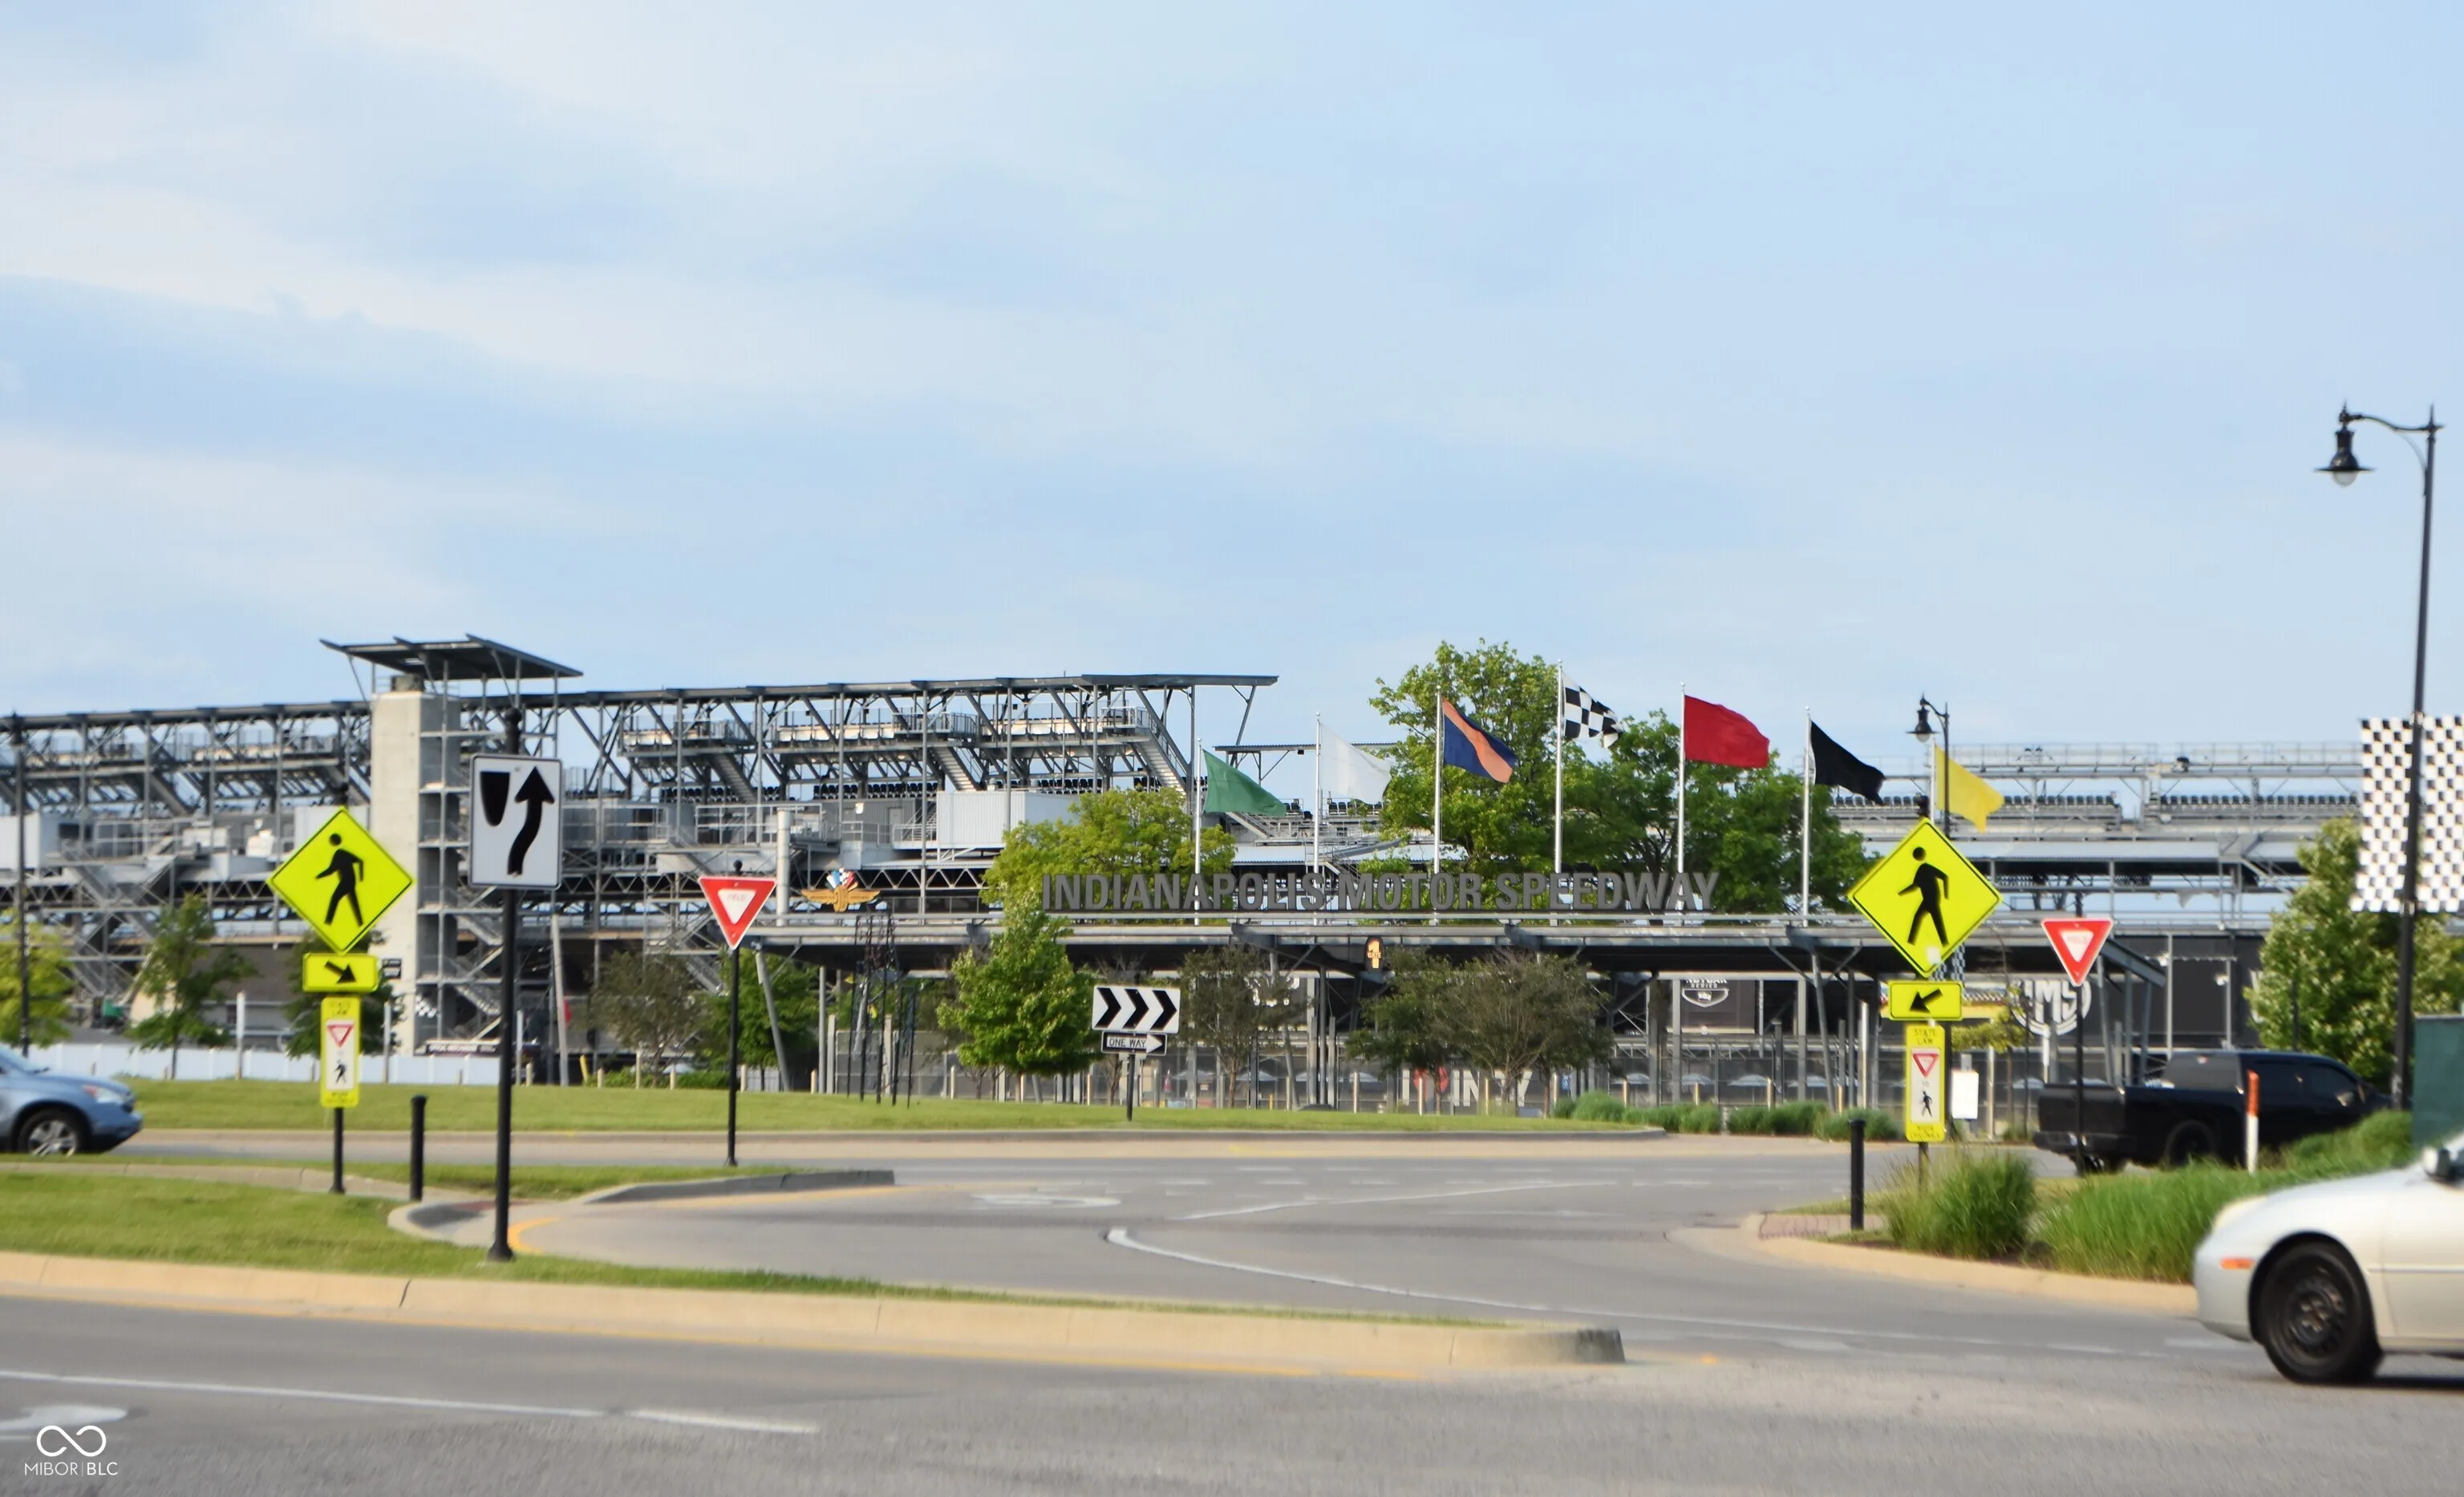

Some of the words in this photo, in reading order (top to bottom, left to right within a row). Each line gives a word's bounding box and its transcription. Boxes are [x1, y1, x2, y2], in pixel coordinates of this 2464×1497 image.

[1043, 872, 1325, 911] INDIANAPOLIS
[1339, 872, 1484, 911] MOTOR
[1495, 872, 1720, 911] SPEEDWAY
[1368, 939, 1380, 968] 1
[1108, 1037, 1126, 1048] ONE
[1129, 1039, 1147, 1050] WAY
